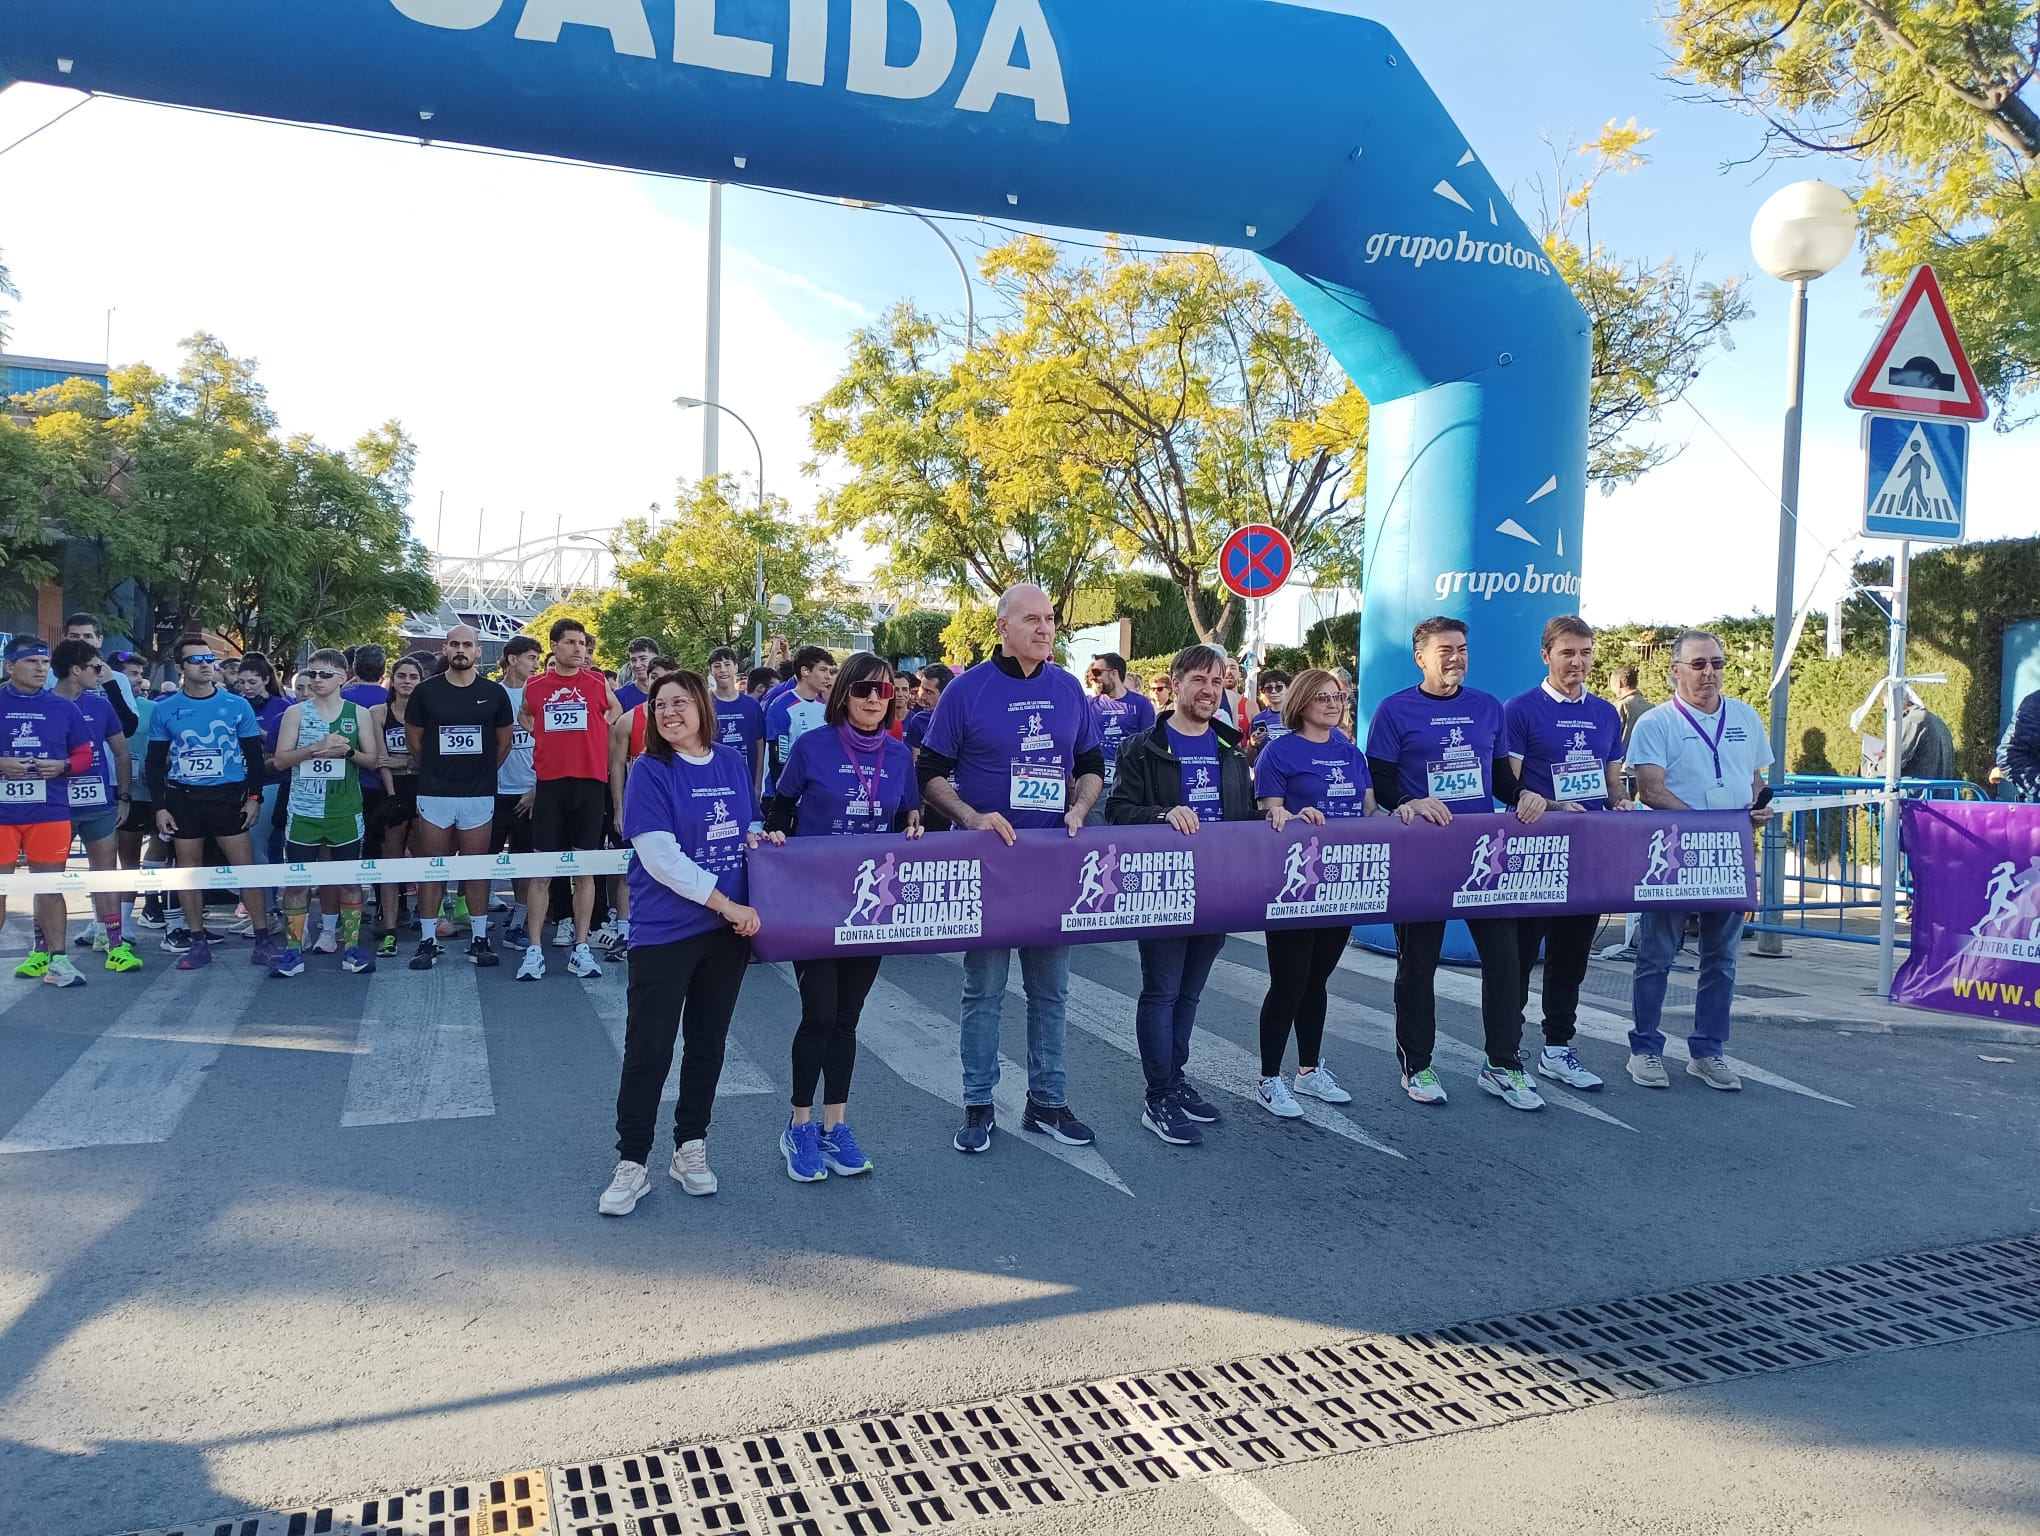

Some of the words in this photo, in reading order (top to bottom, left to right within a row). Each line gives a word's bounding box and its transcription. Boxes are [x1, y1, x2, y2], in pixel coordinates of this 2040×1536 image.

[387, 0, 1070, 124] LIDA
[553, 712, 578, 725] 925
[390, 736, 405, 747] 10
[447, 735, 474, 748] 396
[188, 758, 213, 771] 752
[312, 760, 332, 773] 86
[5, 782, 34, 796] 813
[1018, 780, 1060, 800] 2242
[1433, 772, 1477, 792] 2454
[1560, 773, 1600, 793] 2455
[71, 785, 97, 799] 355
[1506, 835, 1570, 855] CARRERA
[1681, 832, 1742, 850] CARRERA
[1119, 850, 1195, 873] CARRERA
[1321, 842, 1390, 864] CARRERA
[1522, 853, 1542, 872] DE
[1542, 852, 1570, 871] LAS
[1698, 849, 1716, 867] DE
[1718, 848, 1743, 867] LAS
[898, 859, 982, 883] CARRERA
[1141, 871, 1162, 891] DE
[1164, 870, 1195, 891] LAS
[1340, 863, 1361, 882] DE
[1362, 861, 1391, 881] LAS
[1497, 870, 1570, 890] CIUDADES
[1677, 866, 1745, 885] CIUDADES
[922, 881, 945, 903] DE
[948, 879, 981, 901] LAS
[1315, 879, 1390, 901] CIUDADES
[1456, 894, 1483, 904] CONTRA
[1484, 893, 1492, 902] EL
[1519, 891, 1528, 901] DE
[1638, 888, 1664, 898] CONTRA
[1666, 888, 1674, 897] EL
[1702, 886, 1711, 896] DE
[1113, 889, 1196, 912] CIUDADES
[1271, 905, 1299, 916] CONTRA
[1300, 905, 1308, 914] EL
[1339, 903, 1349, 912] DE
[892, 900, 983, 925] CIUDADES
[1066, 917, 1097, 928] CONTRA
[1099, 916, 1108, 926] EL
[1141, 914, 1151, 924] DE
[840, 930, 874, 941] CONTRA
[877, 929, 887, 940] EL
[923, 926, 935, 937] DE
[1971, 940, 2009, 955] CONTRA
[2011, 943, 2025, 957] EL
